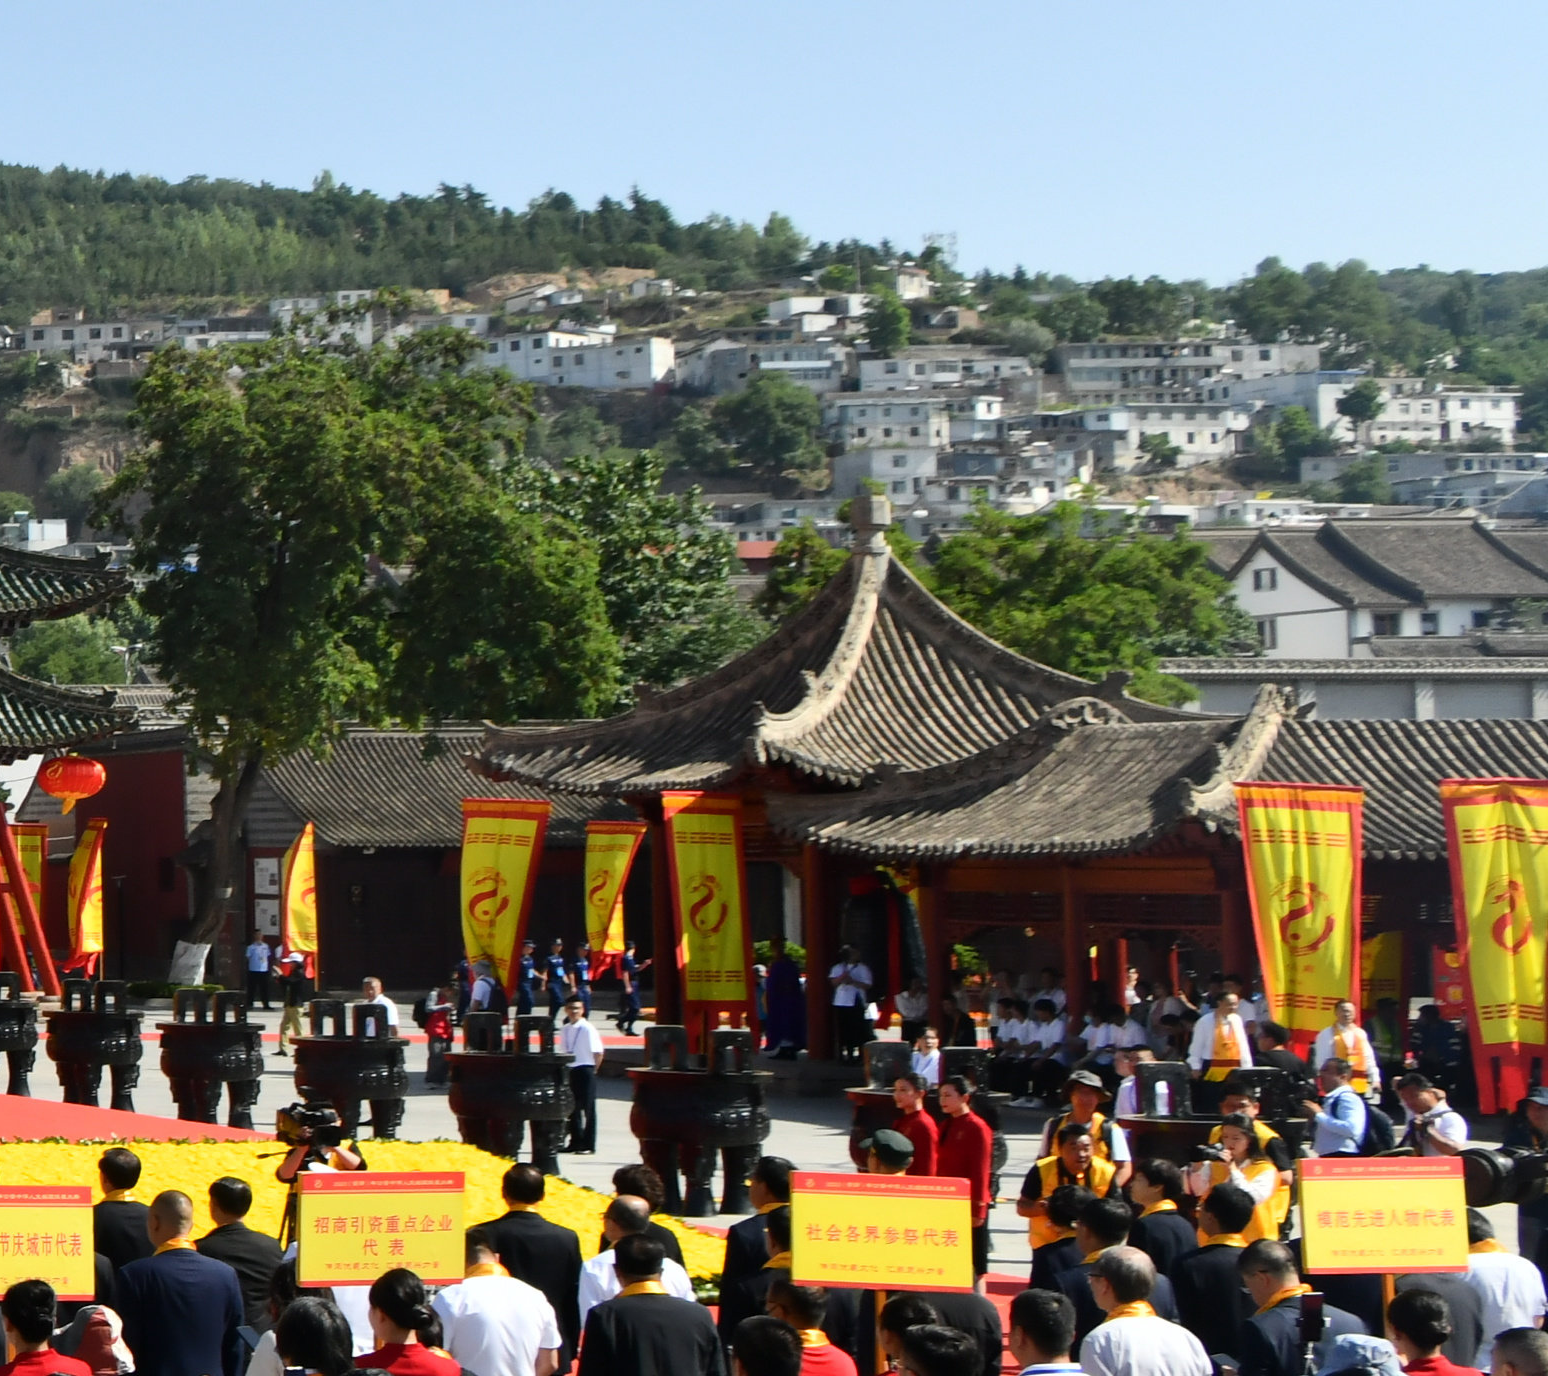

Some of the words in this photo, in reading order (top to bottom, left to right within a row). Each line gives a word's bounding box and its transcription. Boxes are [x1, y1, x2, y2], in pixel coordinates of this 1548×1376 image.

[314, 1214, 453, 1234] 招商引资重点企业
[806, 1223, 959, 1248] 社会各界参祭代表
